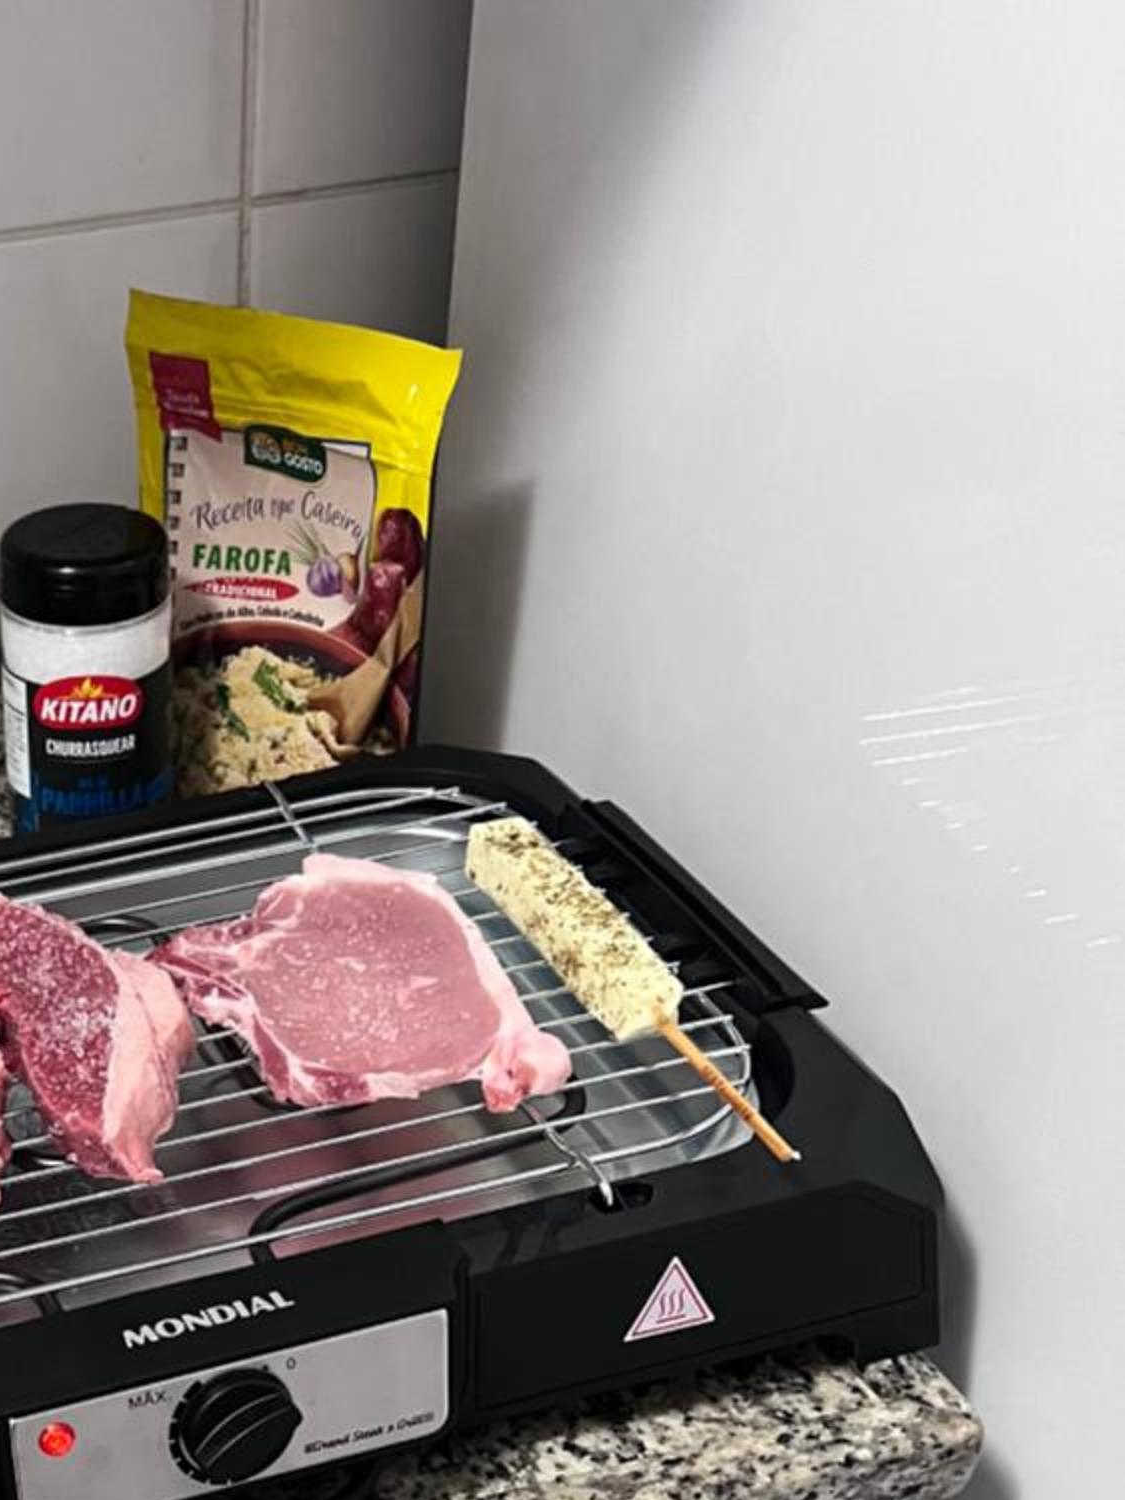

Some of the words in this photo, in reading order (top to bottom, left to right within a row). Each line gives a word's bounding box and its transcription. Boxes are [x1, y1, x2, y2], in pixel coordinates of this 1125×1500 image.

[189, 500, 265, 530] Receita
[192, 543, 292, 577] FAROFA
[40, 693, 137, 724] KITANO
[122, 1289, 296, 1348] MONDIAL
